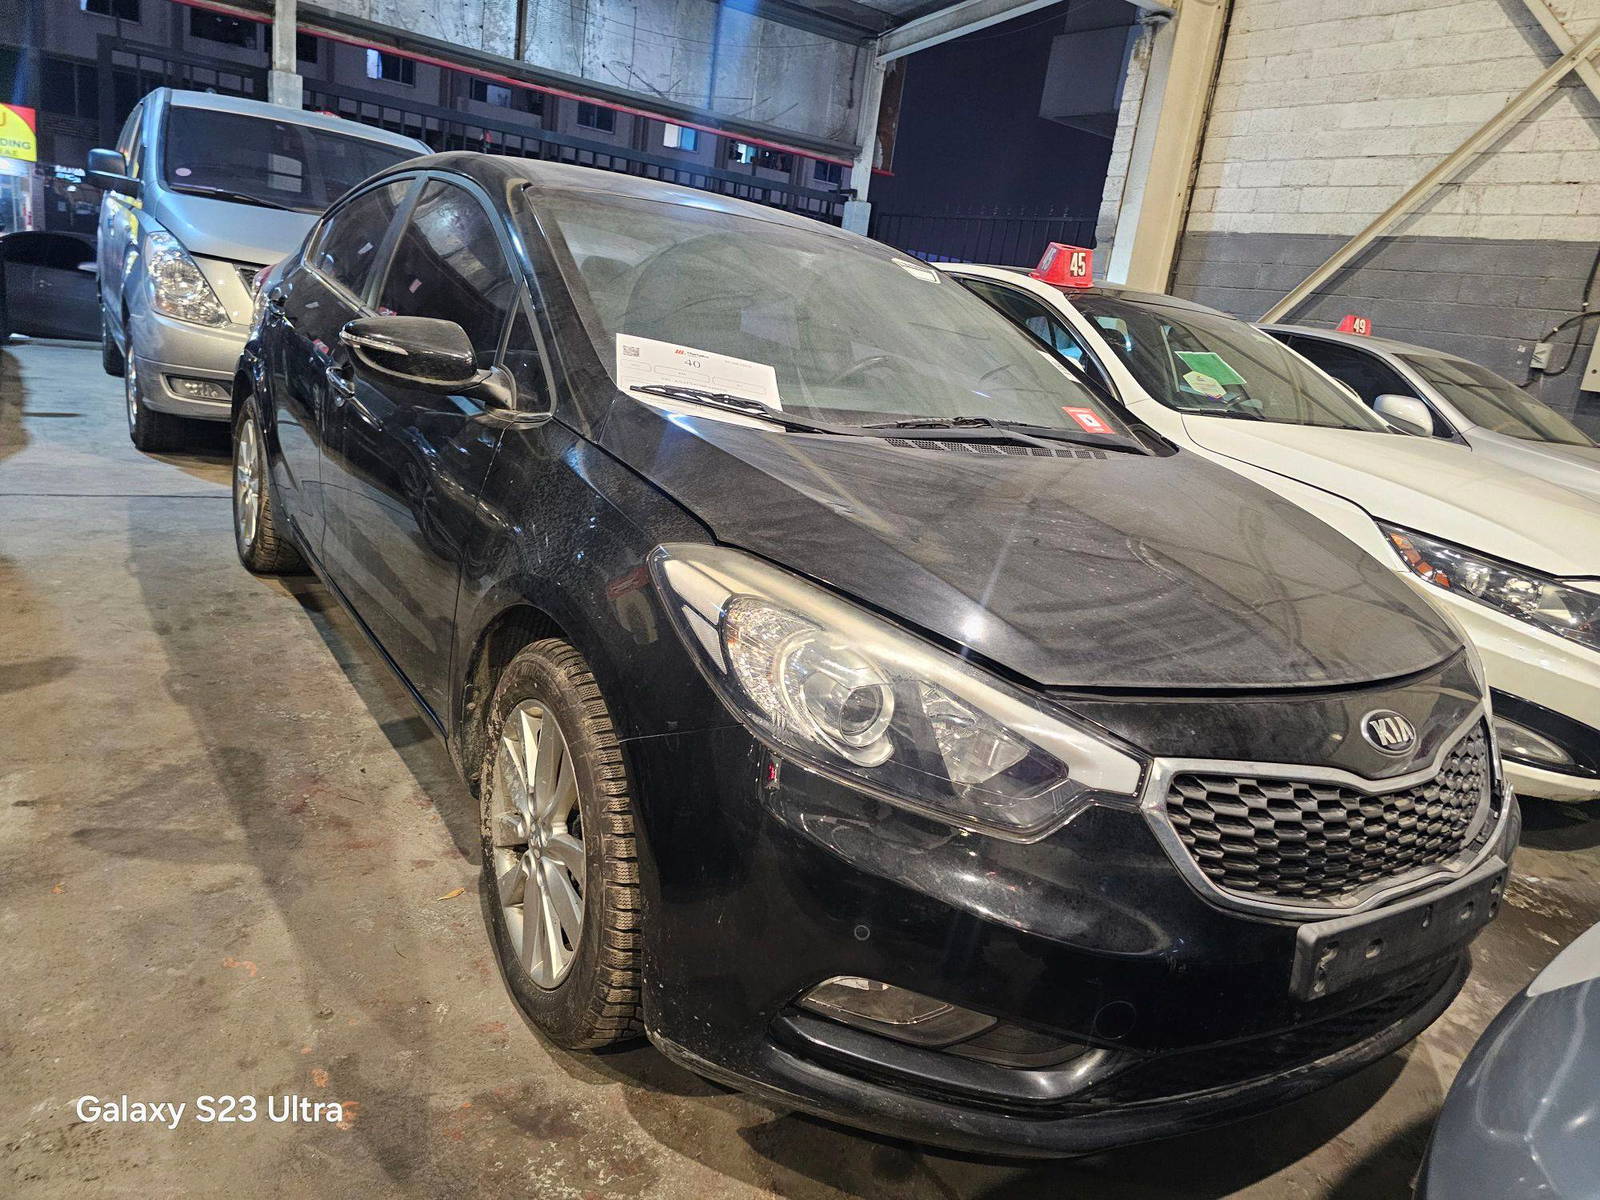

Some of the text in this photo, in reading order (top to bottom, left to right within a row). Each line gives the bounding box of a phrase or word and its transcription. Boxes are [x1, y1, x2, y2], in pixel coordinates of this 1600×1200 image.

[1070, 252, 1086, 277] 45
[1353, 318, 1366, 334] 49
[684, 360, 701, 369] 40
[1369, 716, 1414, 746] KIA
